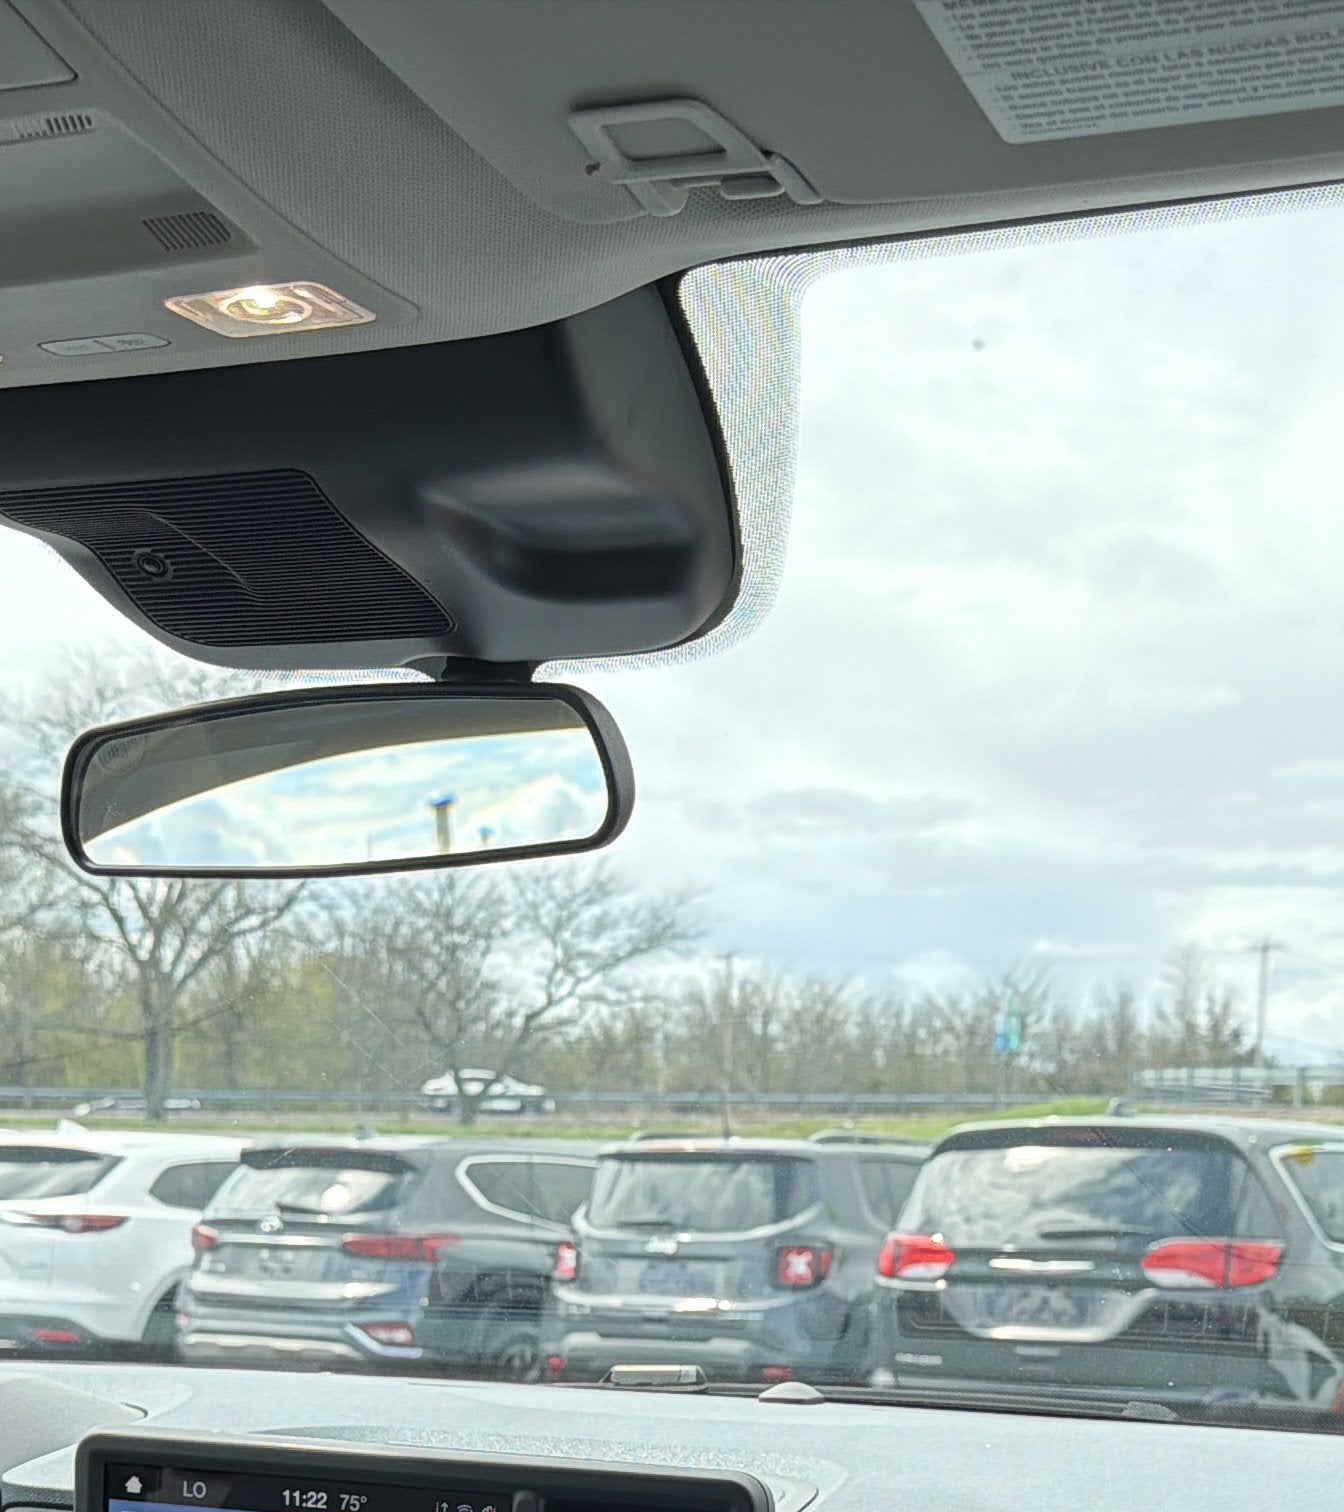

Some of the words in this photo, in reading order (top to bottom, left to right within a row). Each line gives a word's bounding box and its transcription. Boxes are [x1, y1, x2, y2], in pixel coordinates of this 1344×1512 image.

[182, 1480, 207, 1499] LO
[282, 1489, 328, 1511] 11:22
[339, 1492, 368, 1512] 75°
